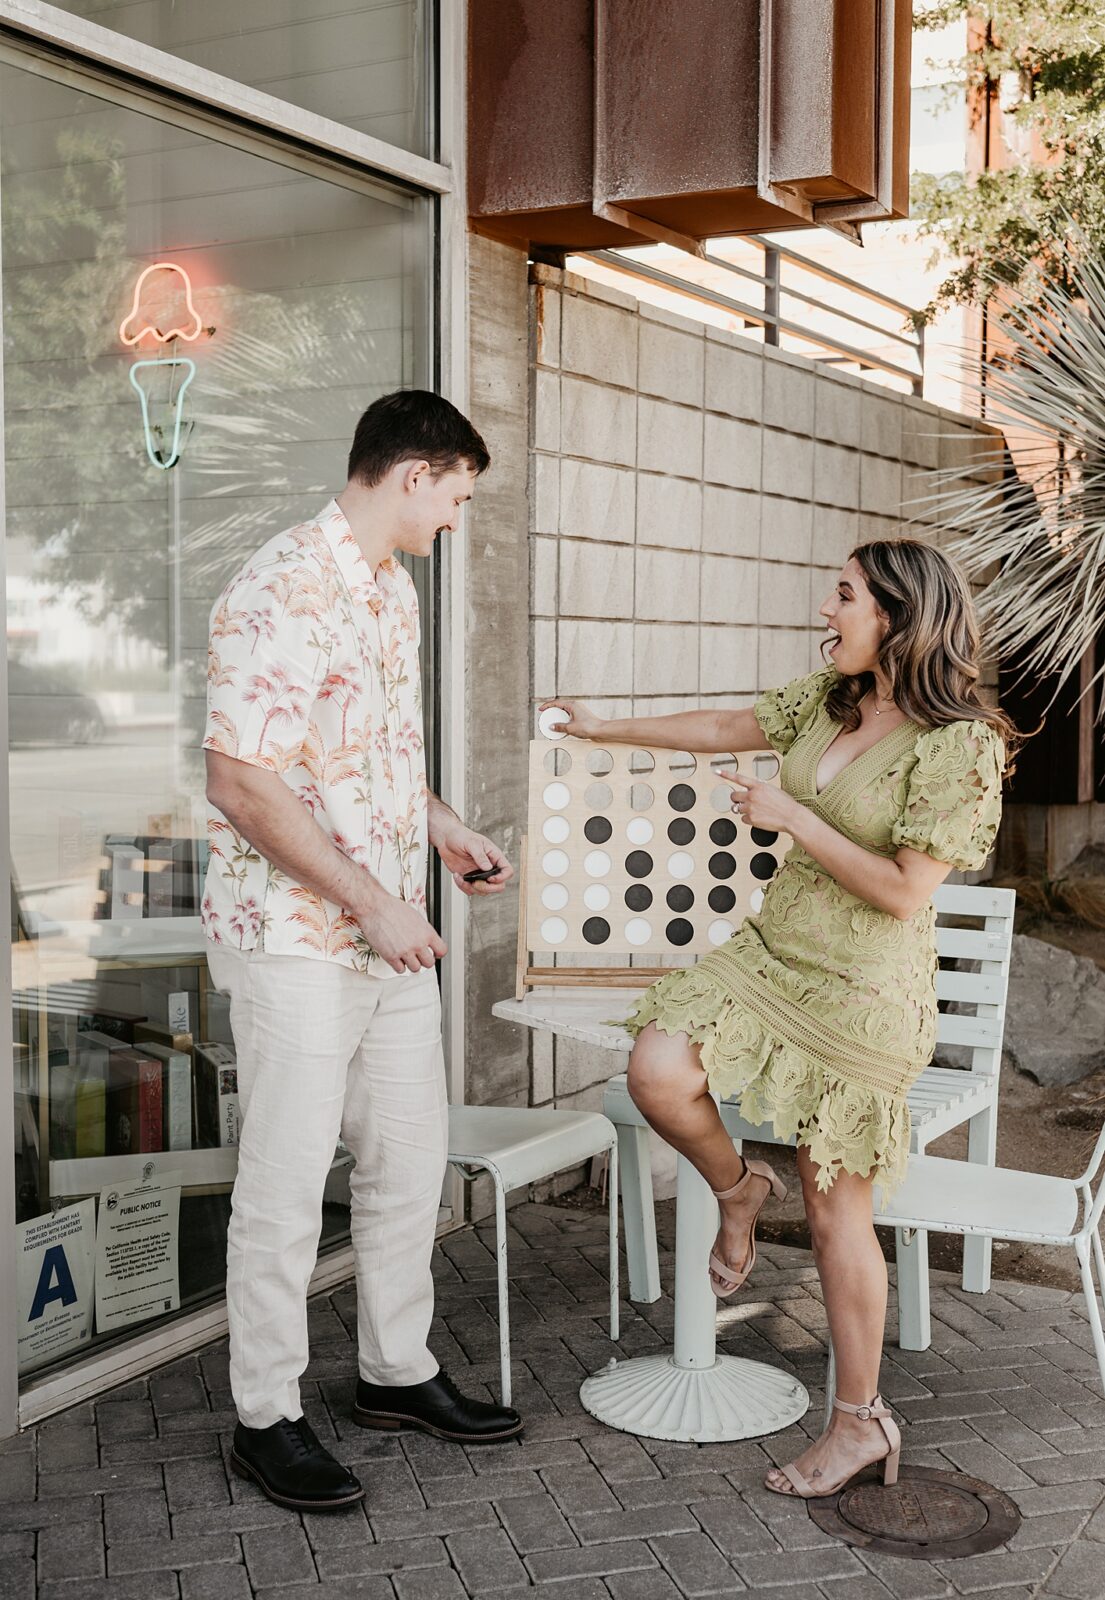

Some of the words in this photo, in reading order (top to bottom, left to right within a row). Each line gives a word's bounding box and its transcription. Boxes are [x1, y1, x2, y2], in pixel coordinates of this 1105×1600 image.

[226, 1102, 235, 1121] Party
[120, 1205, 140, 1216] PUBLIC
[141, 1200, 161, 1210] NOTICE
[25, 1232, 48, 1244] COMPLIED
[60, 1219, 80, 1230] SANITARY
[26, 1228, 36, 1236] THIS
[36, 1216, 70, 1232] ESTABLISHMENT
[24, 1235, 57, 1252] REQUIREMENTS
[68, 1226, 82, 1235] GRADE
[28, 1244, 78, 1322] A
